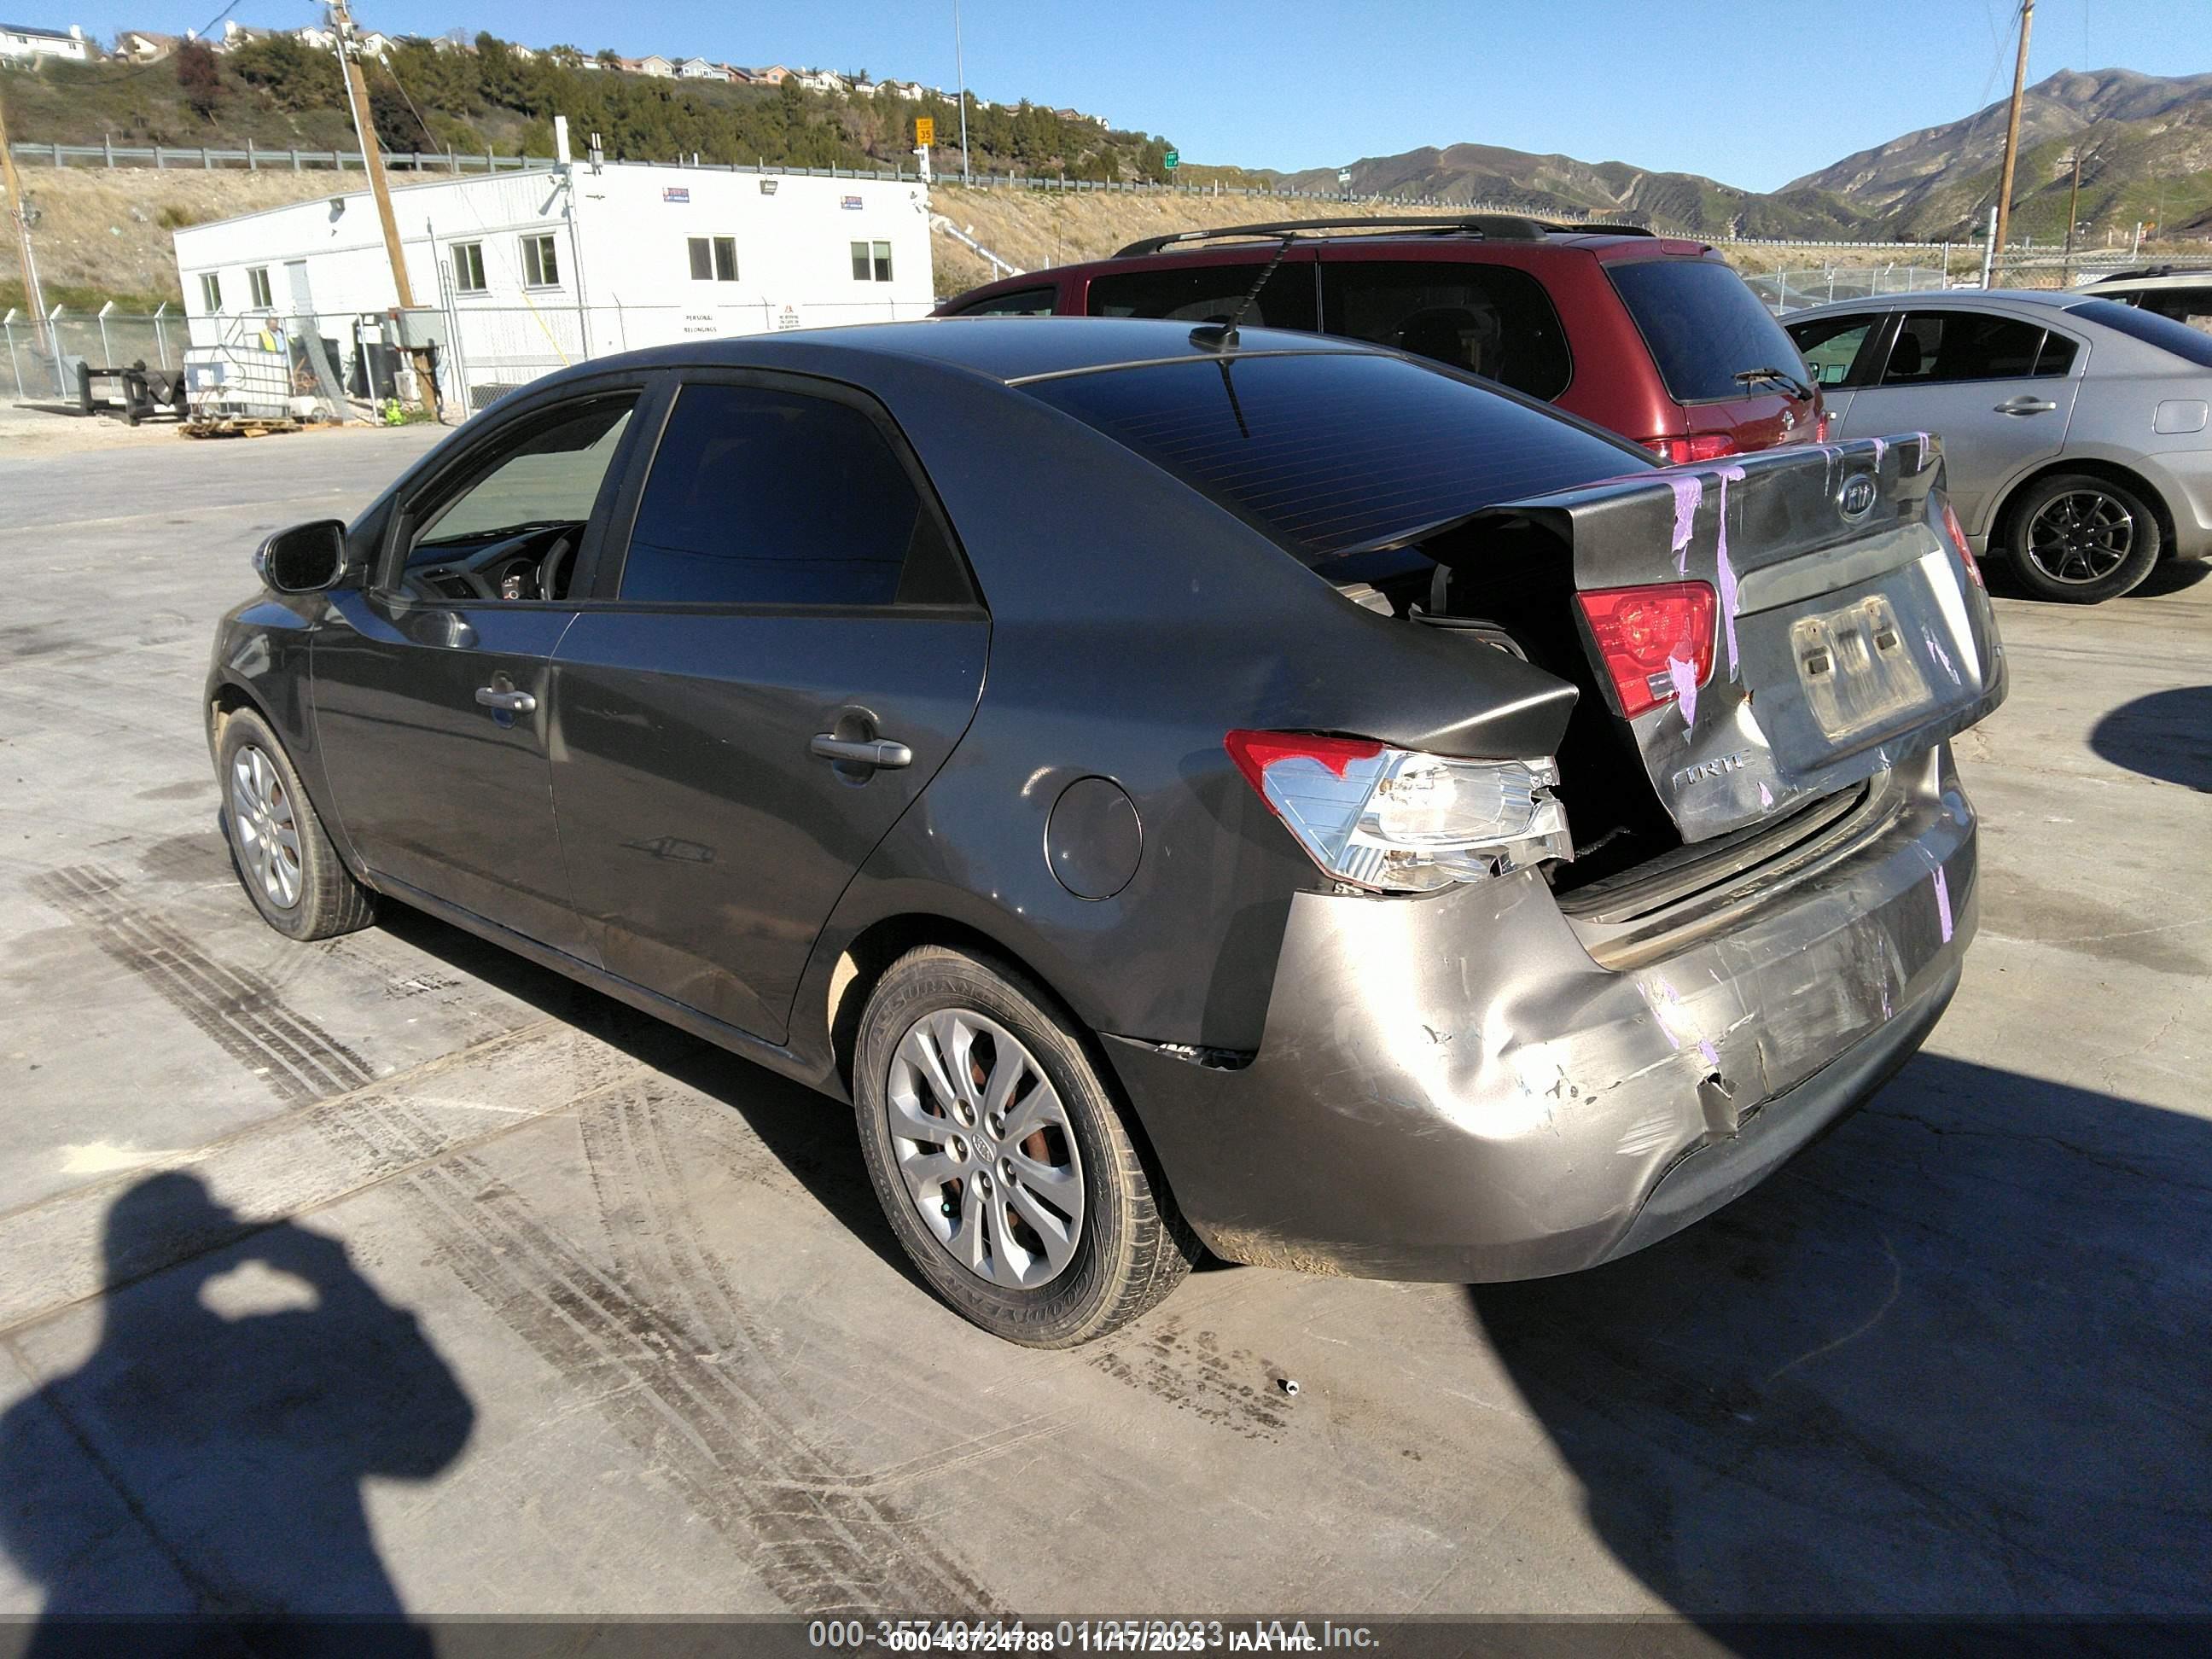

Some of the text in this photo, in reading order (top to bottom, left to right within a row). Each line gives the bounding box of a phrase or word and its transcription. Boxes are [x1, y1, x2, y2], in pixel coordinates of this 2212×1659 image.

[920, 130, 931, 139] 35
[1672, 748, 1756, 794] FORTE
[945, 1272, 1091, 1324] GOODYEAR
